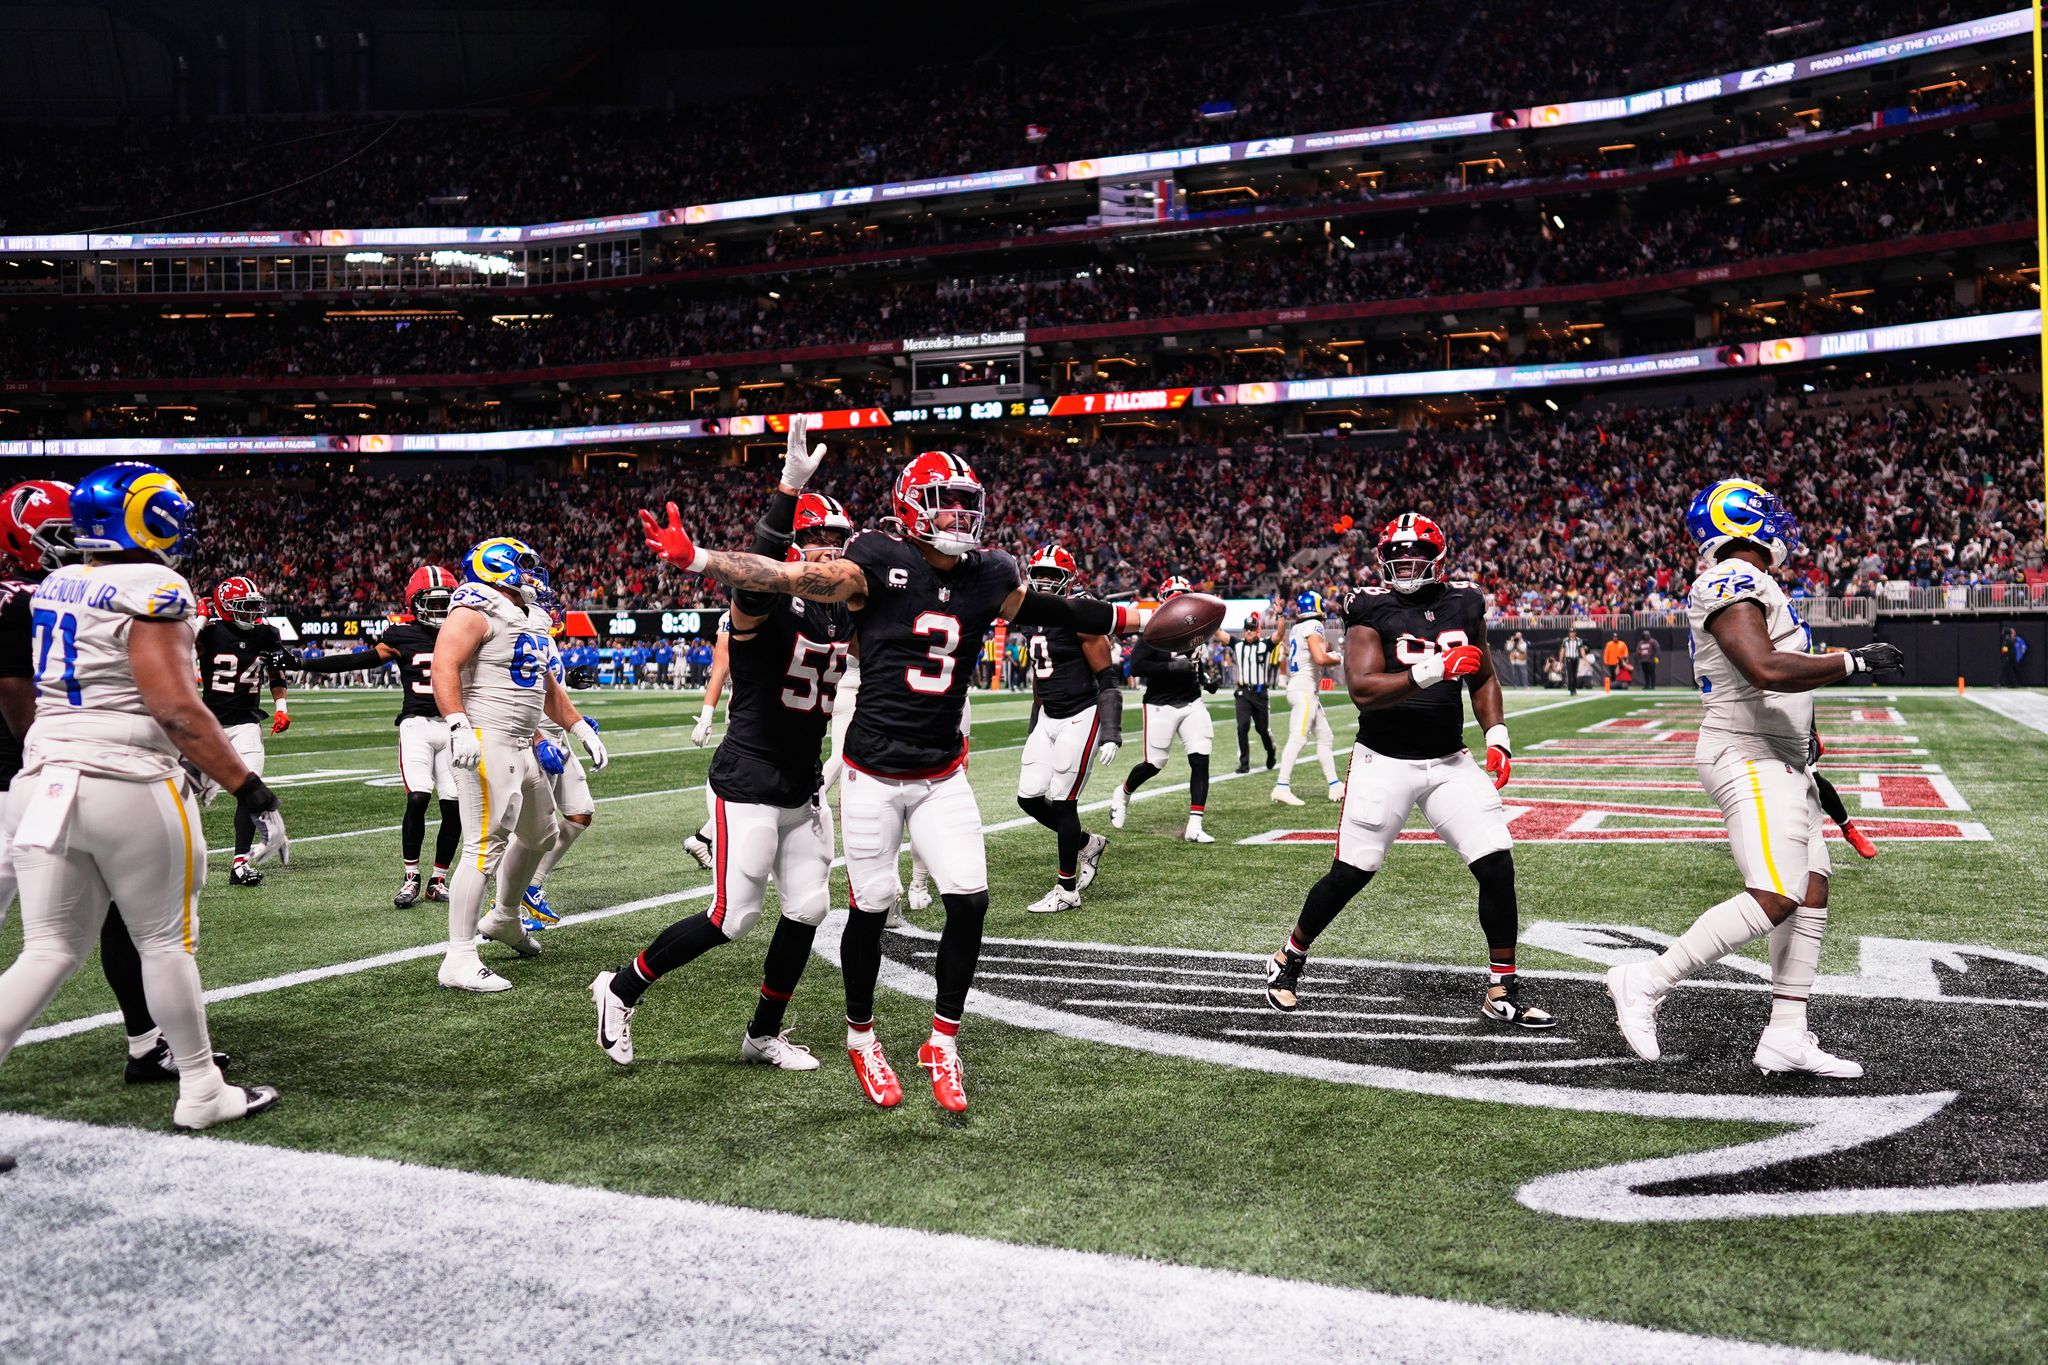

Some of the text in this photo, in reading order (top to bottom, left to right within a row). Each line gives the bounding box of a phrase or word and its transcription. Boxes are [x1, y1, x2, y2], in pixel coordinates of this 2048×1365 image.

[1809, 18, 2021, 71] PROUD PARTNER OF THE ATLANTA FALCONS
[1585, 79, 1721, 119] ATLANTA MOVES THE CHAINS
[1305, 120, 1477, 147] PROUD PARTNER OF THE ATLANTA FALCONS
[167, 237, 195, 245] PARTNER
[206, 236, 219, 244] THE
[250, 235, 280, 243] FALCONS
[903, 334, 978, 351] Mercedes-Benz
[980, 331, 1025, 345] Stadium
[1820, 332, 1868, 355] ATLANTA
[1874, 327, 1914, 349] MOVES
[1918, 324, 1938, 345] THE
[1943, 318, 1989, 341] CHAINS
[1511, 356, 1700, 381] PROUD PARTNER OF THE ATLANTA FALCONS
[1289, 382, 1328, 398] ATLANTA
[970, 402, 1003, 419] 8:30
[1010, 403, 1025, 416] 25
[1083, 390, 1167, 412] 7 FALCONS
[893, 410, 912, 422] 3RD
[621, 428, 633, 437] THE
[633, 427, 661, 436] ATLANTA
[661, 425, 690, 434] FALCONS
[32, 442, 59, 454] MOVES
[62, 442, 75, 454] THE
[228, 441, 238, 449] OF
[239, 441, 253, 449] THE
[253, 441, 284, 449] ATLANTA
[285, 440, 316, 448] FALCONS
[403, 436, 435, 449] ATLANTA
[888, 567, 908, 585] C
[1708, 575, 1755, 598] 72
[88, 583, 117, 609] JR
[791, 596, 805, 613] C
[301, 622, 338, 634] 3RD & 3
[344, 621, 358, 635] 25
[609, 619, 636, 635] 2ND
[661, 612, 701, 634] 8:30
[32, 608, 82, 706] 71
[509, 633, 550, 688] 67
[904, 610, 962, 695] 3
[1029, 635, 1054, 680] 0
[1288, 638, 1299, 673] 2
[211, 654, 260, 694] 24
